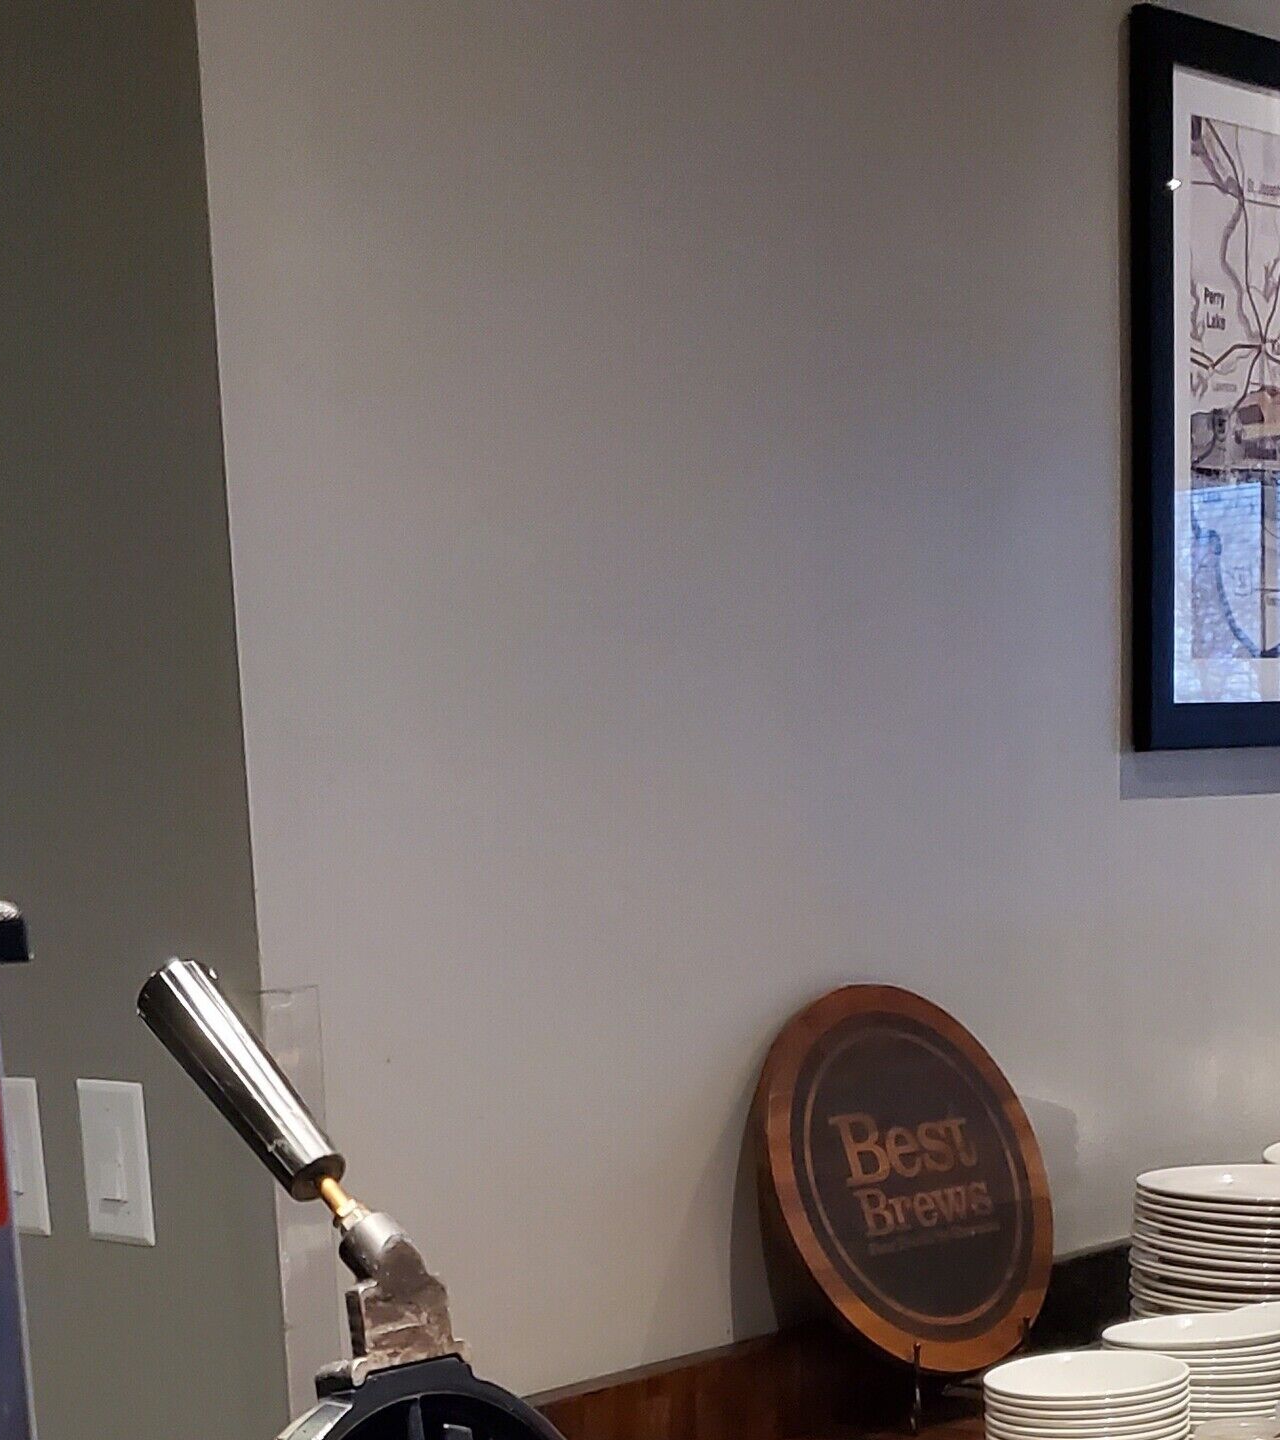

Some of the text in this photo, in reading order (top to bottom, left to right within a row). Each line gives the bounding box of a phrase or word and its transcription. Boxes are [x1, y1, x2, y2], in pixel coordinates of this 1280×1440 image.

[1204, 286, 1226, 310] Perry
[1206, 311, 1227, 331] Lake
[827, 1110, 980, 1187] Best
[852, 1180, 995, 1239] Brews
